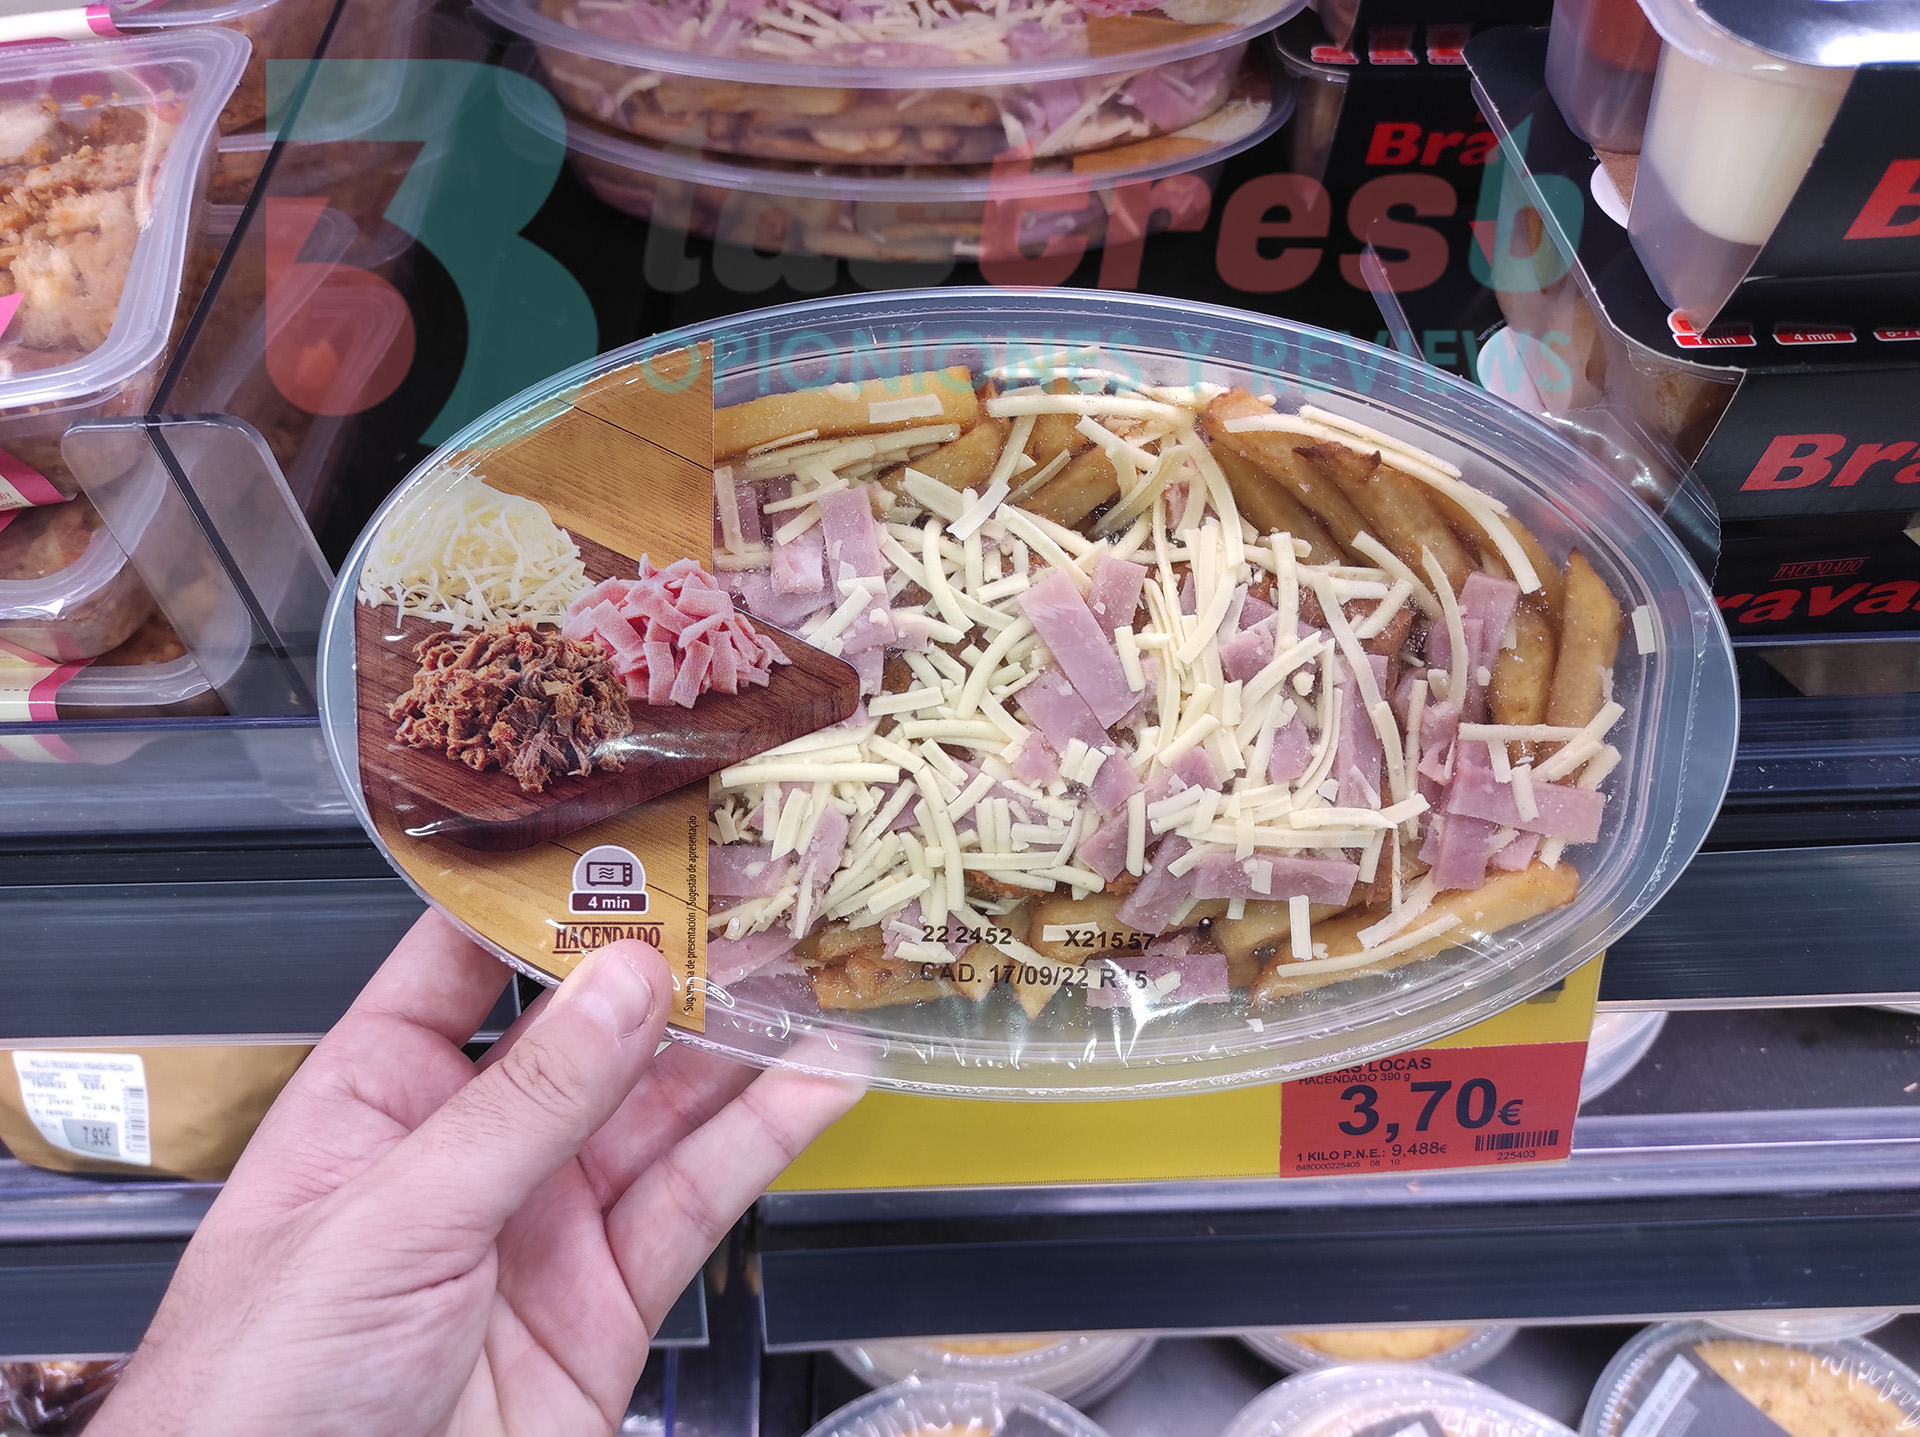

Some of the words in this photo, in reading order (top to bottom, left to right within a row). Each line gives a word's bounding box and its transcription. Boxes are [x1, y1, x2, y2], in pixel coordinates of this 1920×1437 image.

[688, 815, 699, 862] apresentação
[687, 862, 697, 872] de
[588, 897, 599, 909] 4
[602, 896, 631, 909] min
[555, 925, 661, 949] HACENDADO
[686, 912, 698, 956] presentación
[956, 926, 1012, 945] 2452
[685, 958, 696, 970] de
[920, 962, 981, 983] CAD.
[990, 964, 1088, 987] 17/09/22
[1368, 1057, 1432, 1073] LOCAS
[1299, 1072, 1377, 1086] HACENDADO
[1380, 1072, 1401, 1082] 390
[1403, 1073, 1411, 1083] g
[1338, 1077, 1524, 1143] 3,70€
[1296, 1152, 1303, 1162] 1
[1308, 1151, 1340, 1162] KILO
[1343, 1148, 1386, 1160] P.N.E.:
[1390, 1158, 1400, 1166] 10
[1496, 1150, 1536, 1161] 225403
